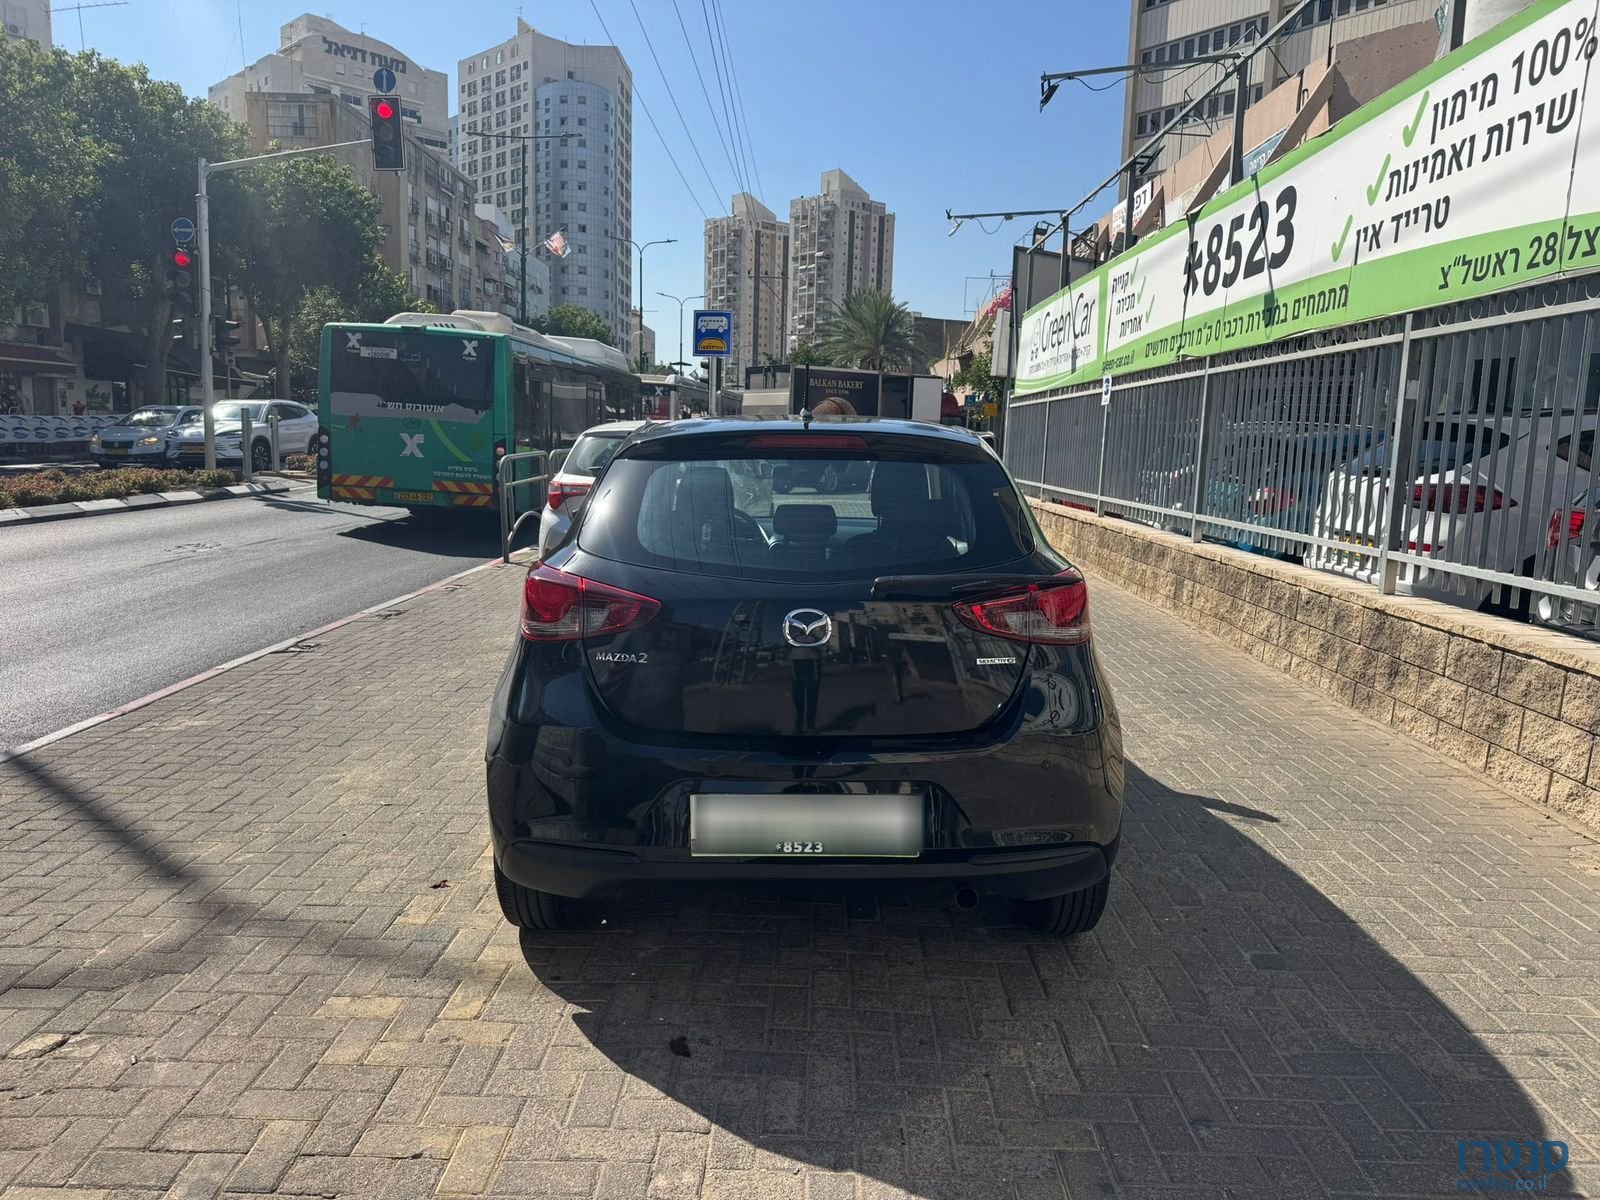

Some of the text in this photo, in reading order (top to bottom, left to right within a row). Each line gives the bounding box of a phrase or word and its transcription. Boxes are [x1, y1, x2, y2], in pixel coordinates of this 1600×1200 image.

[1430, 17, 1598, 145] 100% מימון
[1385, 88, 1578, 202] שירות ואמינות
[1354, 195, 1450, 266] טרייד אין
[1527, 231, 1558, 270] 28
[1116, 293, 1135, 315] מכירה
[1292, 283, 1349, 320] מתמחים
[1119, 314, 1143, 338] אחריות
[1223, 316, 1244, 339] רכבי
[1245, 302, 1288, 333] במכירת
[1145, 337, 1168, 358] חדשים
[1170, 329, 1194, 352] ורכבים
[810, 378, 864, 389] BALKAN BAKERY
[405, 403, 445, 413] אוטובוס
